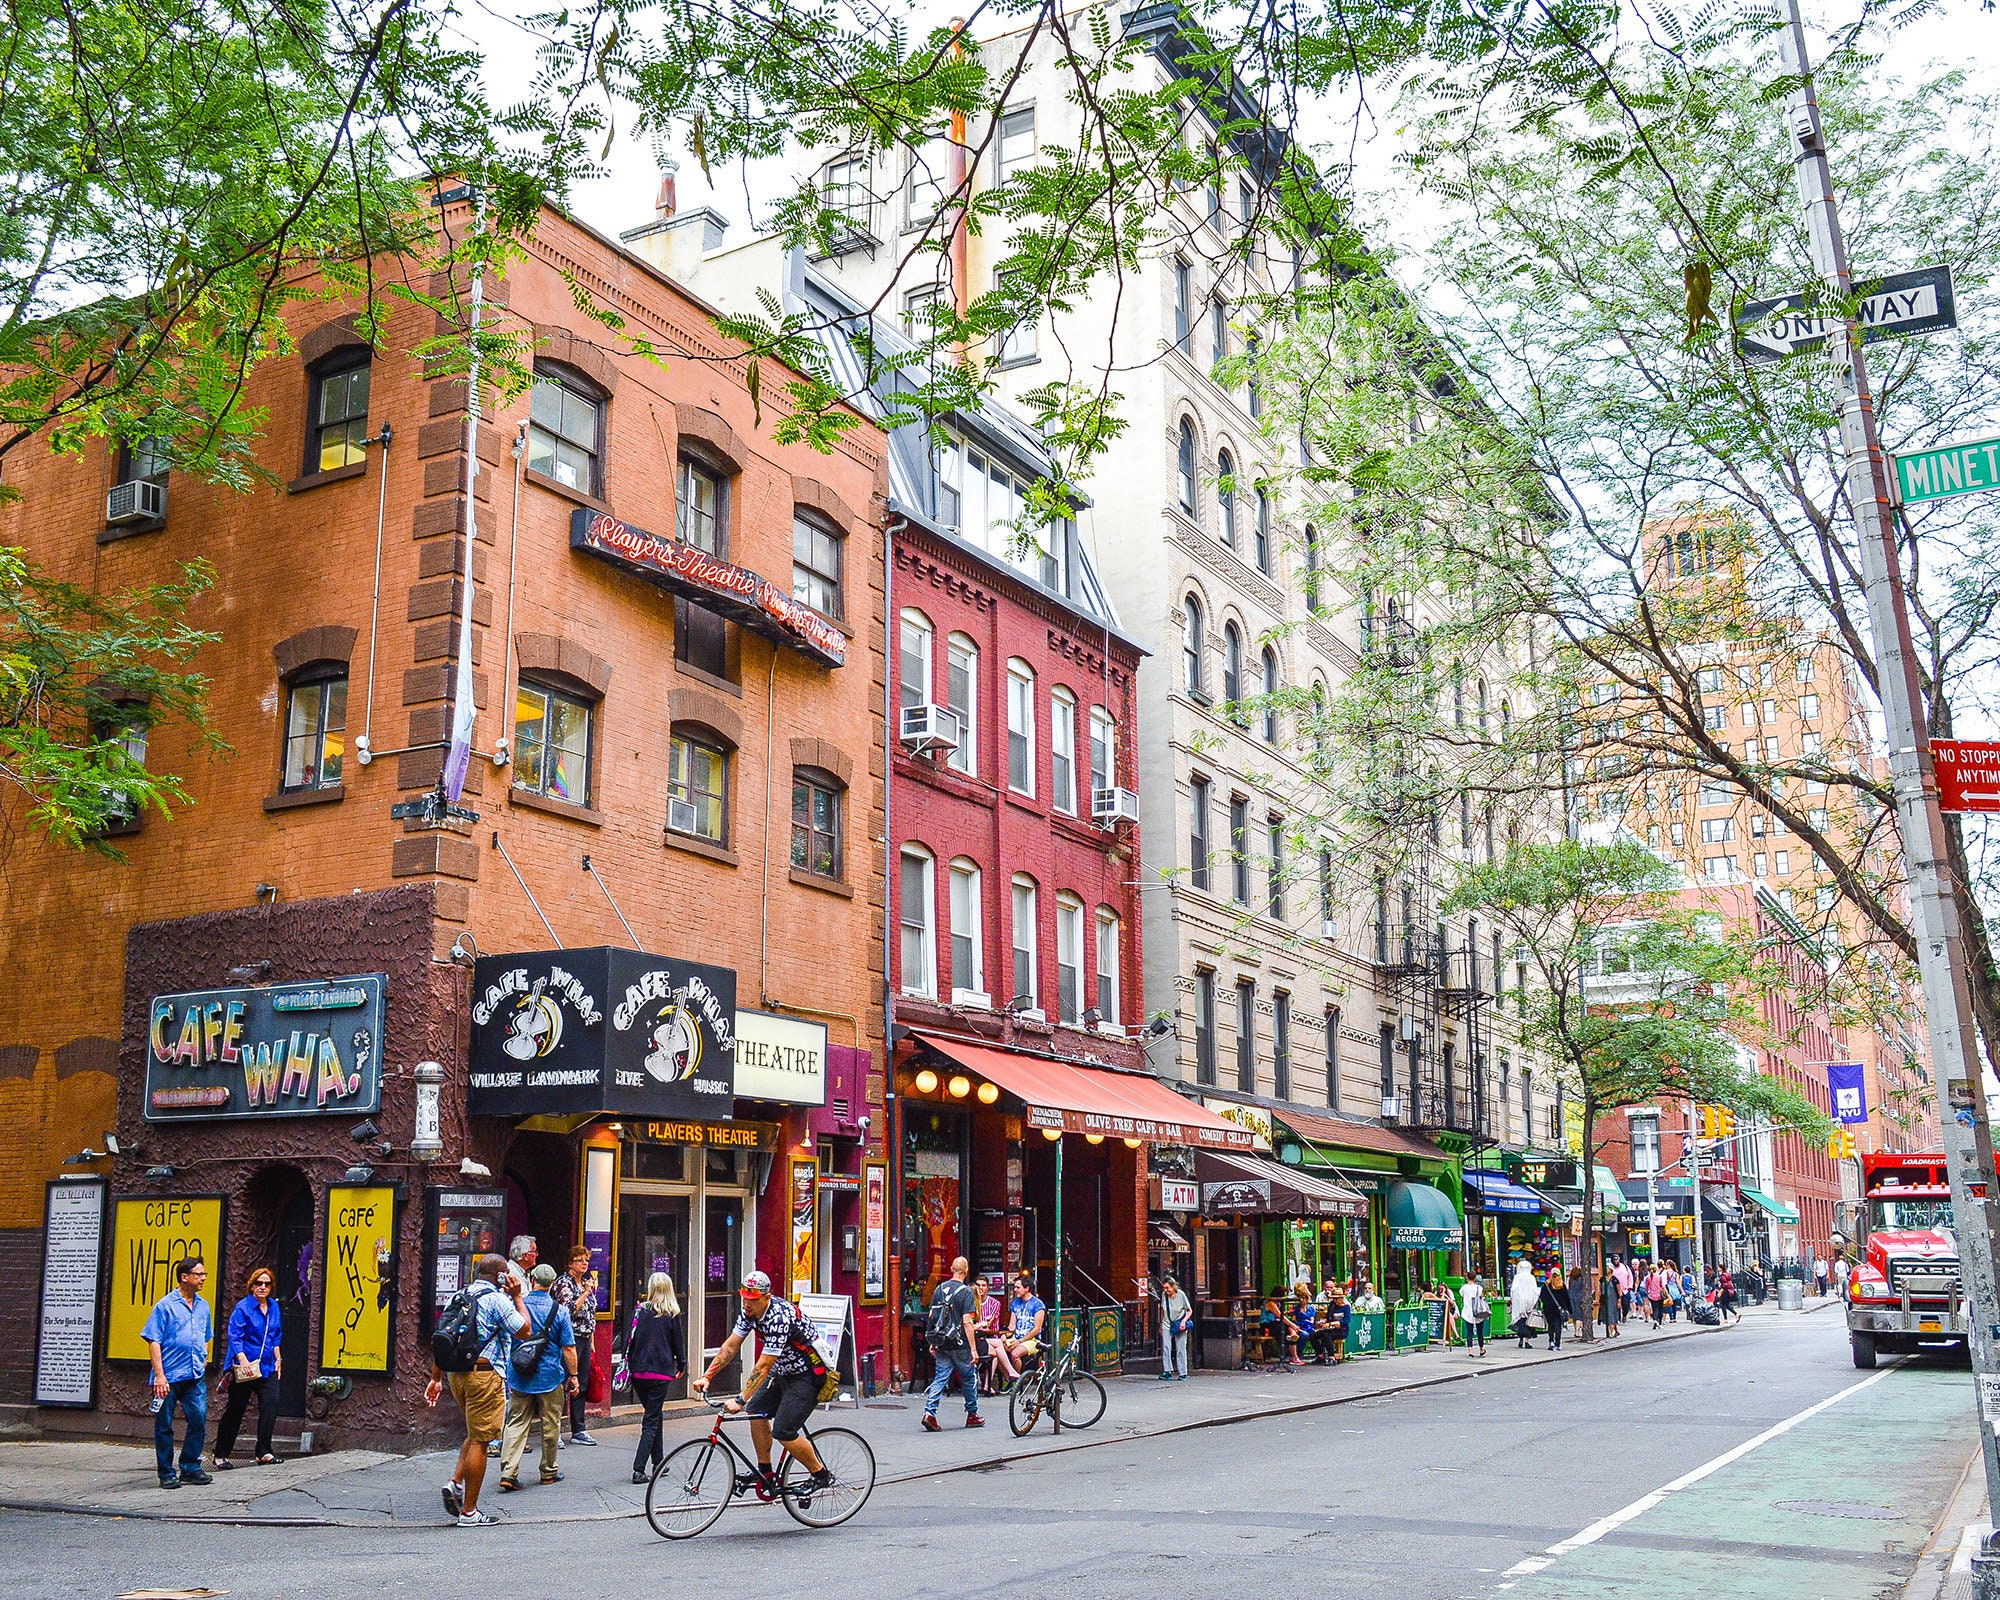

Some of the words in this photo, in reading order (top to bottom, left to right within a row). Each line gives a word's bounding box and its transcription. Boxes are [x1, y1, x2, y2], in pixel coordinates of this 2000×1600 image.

[1770, 314, 1827, 341] ON
[1857, 290, 1920, 324] WAY
[675, 547, 756, 593] Theatre
[1939, 748, 1956, 763] NO
[473, 968, 529, 1027] CAFE
[613, 970, 673, 1032] CAFE
[151, 1001, 245, 1068] CAFE
[735, 1039, 819, 1075] THEATRE
[470, 1072, 524, 1088] VILLAGE
[527, 1069, 601, 1086] LANDMARK
[615, 1069, 646, 1088] LIVE
[693, 1078, 730, 1096] MUSIC
[1031, 1106, 1063, 1117] MENACHEM
[1838, 1108, 1861, 1118] NYU
[648, 1122, 704, 1142] PLAYERS
[706, 1126, 760, 1147] THEATRE
[1085, 1114, 1112, 1129] OLIVE
[1112, 1117, 1134, 1132] TREE
[1135, 1120, 1157, 1134] CAFE
[1165, 1123, 1183, 1137] BAR
[1198, 1128, 1226, 1142] COMEDY
[1227, 1132, 1253, 1145] CELLAR
[442, 1193, 469, 1207] CAFE
[1173, 1187, 1200, 1205] ATM
[1148, 1238, 1169, 1247] ATM
[1177, 1243, 1189, 1252] ATM
[1395, 1235, 1427, 1243] REGGIO
[1896, 1266, 1959, 1274] MACK
[44, 1316, 54, 1326] The
[54, 1316, 65, 1326] New
[65, 1317, 77, 1328] York
[77, 1317, 93, 1326] Times
